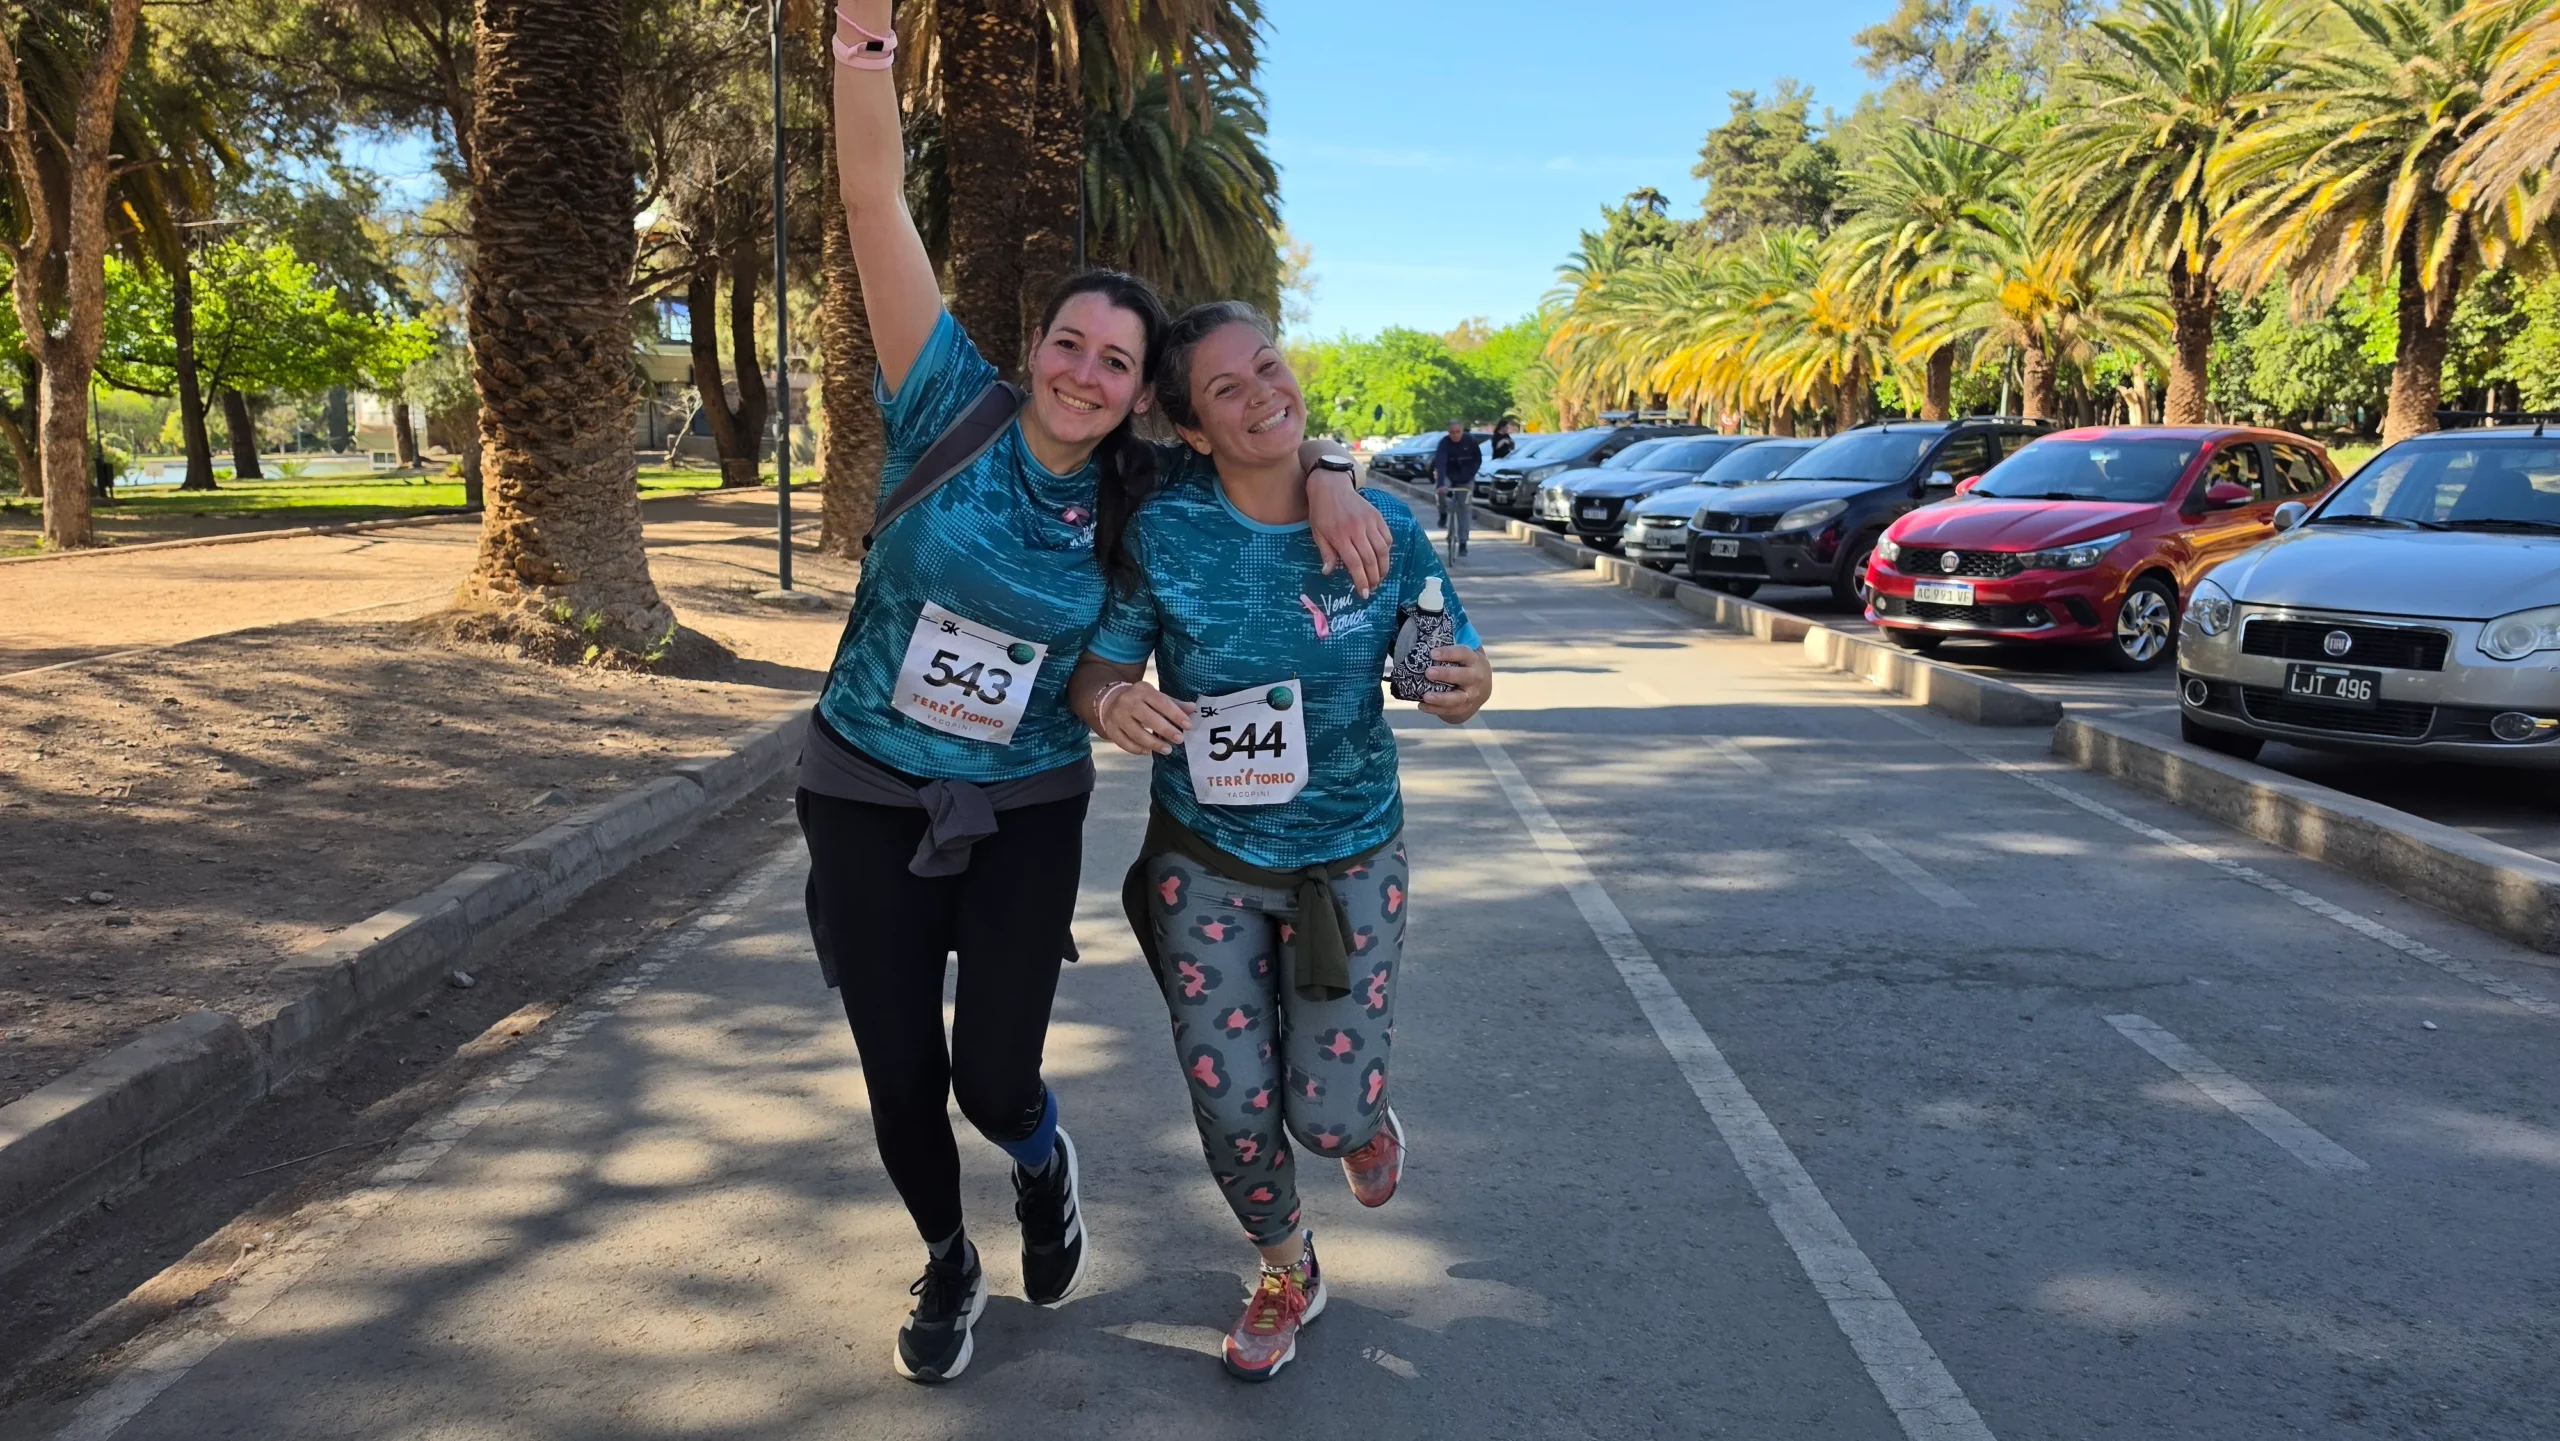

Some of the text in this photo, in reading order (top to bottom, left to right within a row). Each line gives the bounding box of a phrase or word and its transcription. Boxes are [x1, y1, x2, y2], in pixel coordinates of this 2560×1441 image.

[1917, 588, 1930, 599] AC
[1933, 589, 1953, 602] 991
[2329, 637, 2346, 650] FIAT
[922, 649, 1013, 705] 543
[2290, 672, 2372, 700] LJT 496
[926, 713, 972, 731] YACOPINI
[1208, 721, 1287, 762] 544
[1227, 790, 1270, 798] YACOPINI
